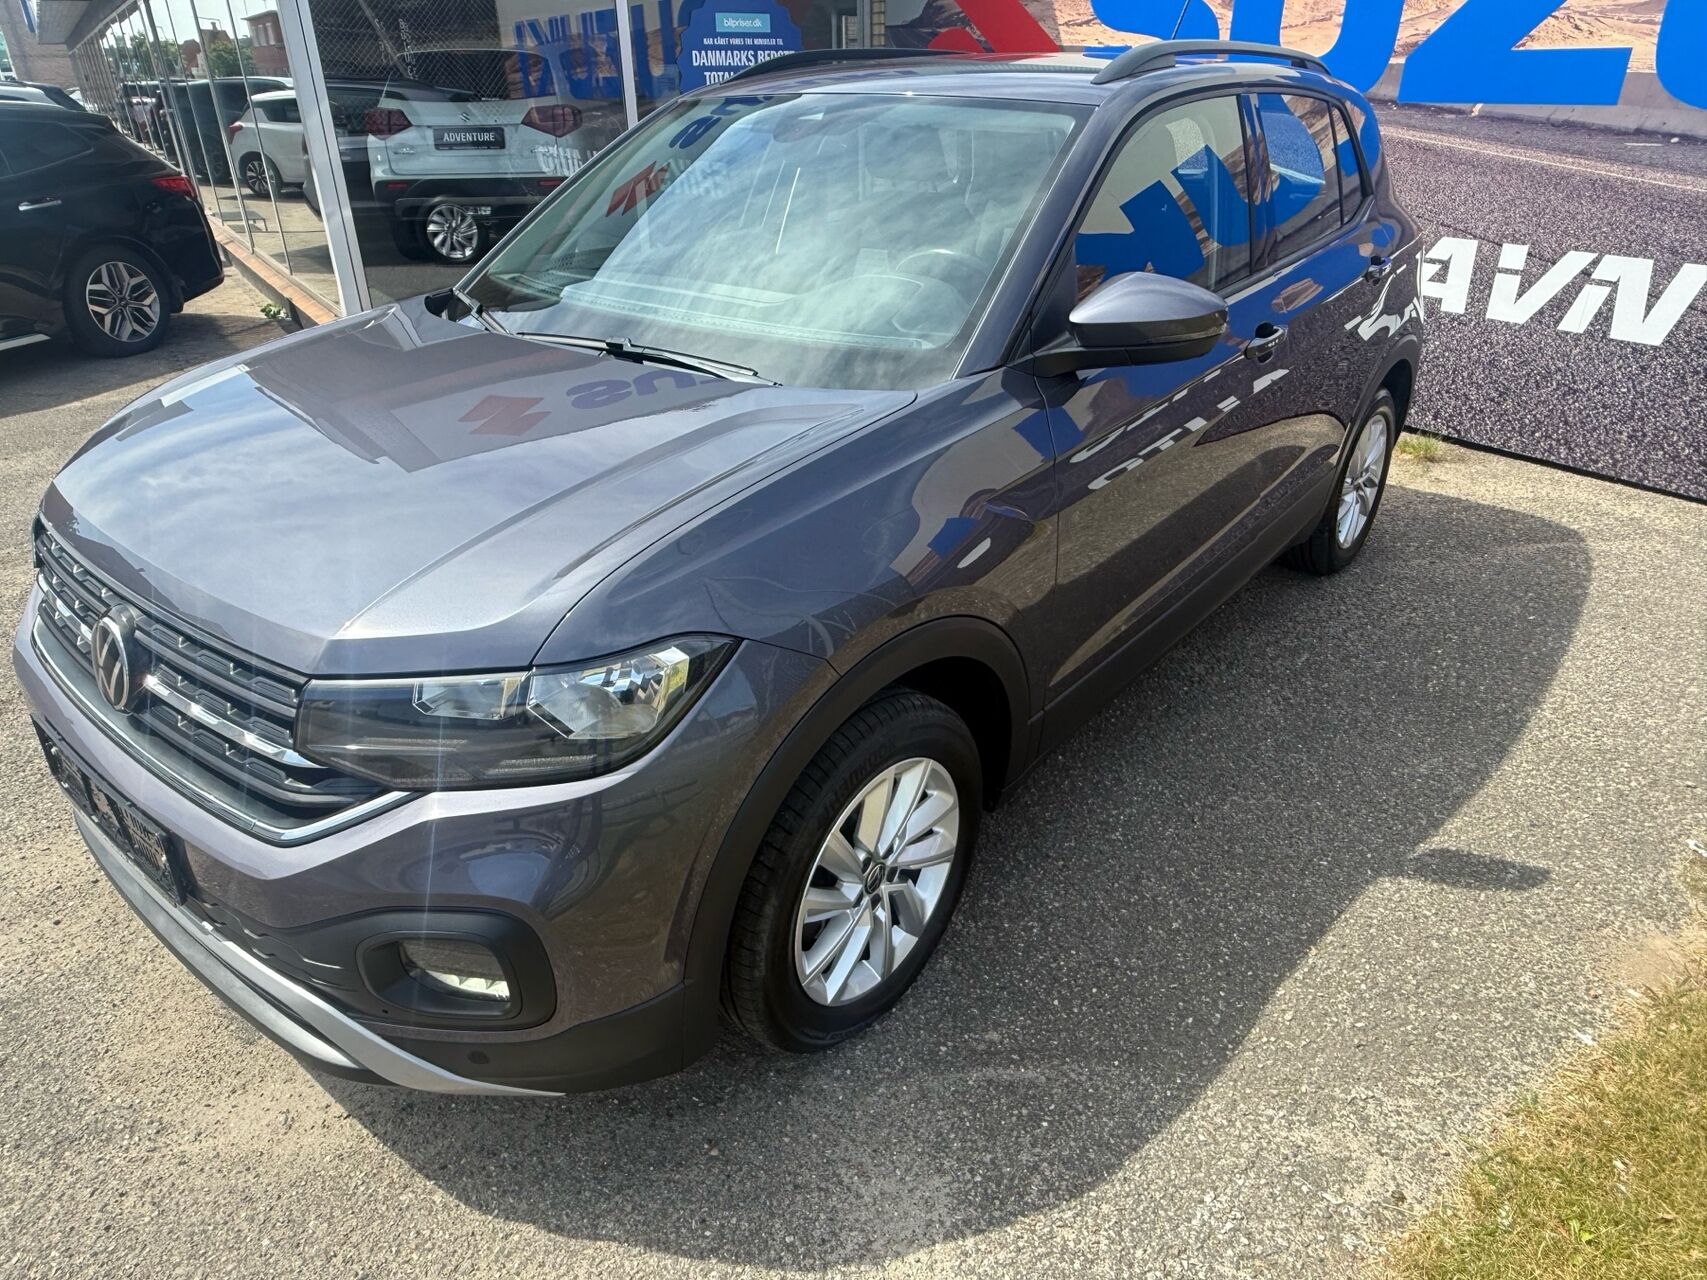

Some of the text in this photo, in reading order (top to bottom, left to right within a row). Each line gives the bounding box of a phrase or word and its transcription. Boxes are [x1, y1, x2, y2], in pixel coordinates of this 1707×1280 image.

[723, 18, 762, 28] bilpriser.dk
[692, 50, 755, 66] DANMARKS
[443, 132, 496, 142] ADVENTURE
